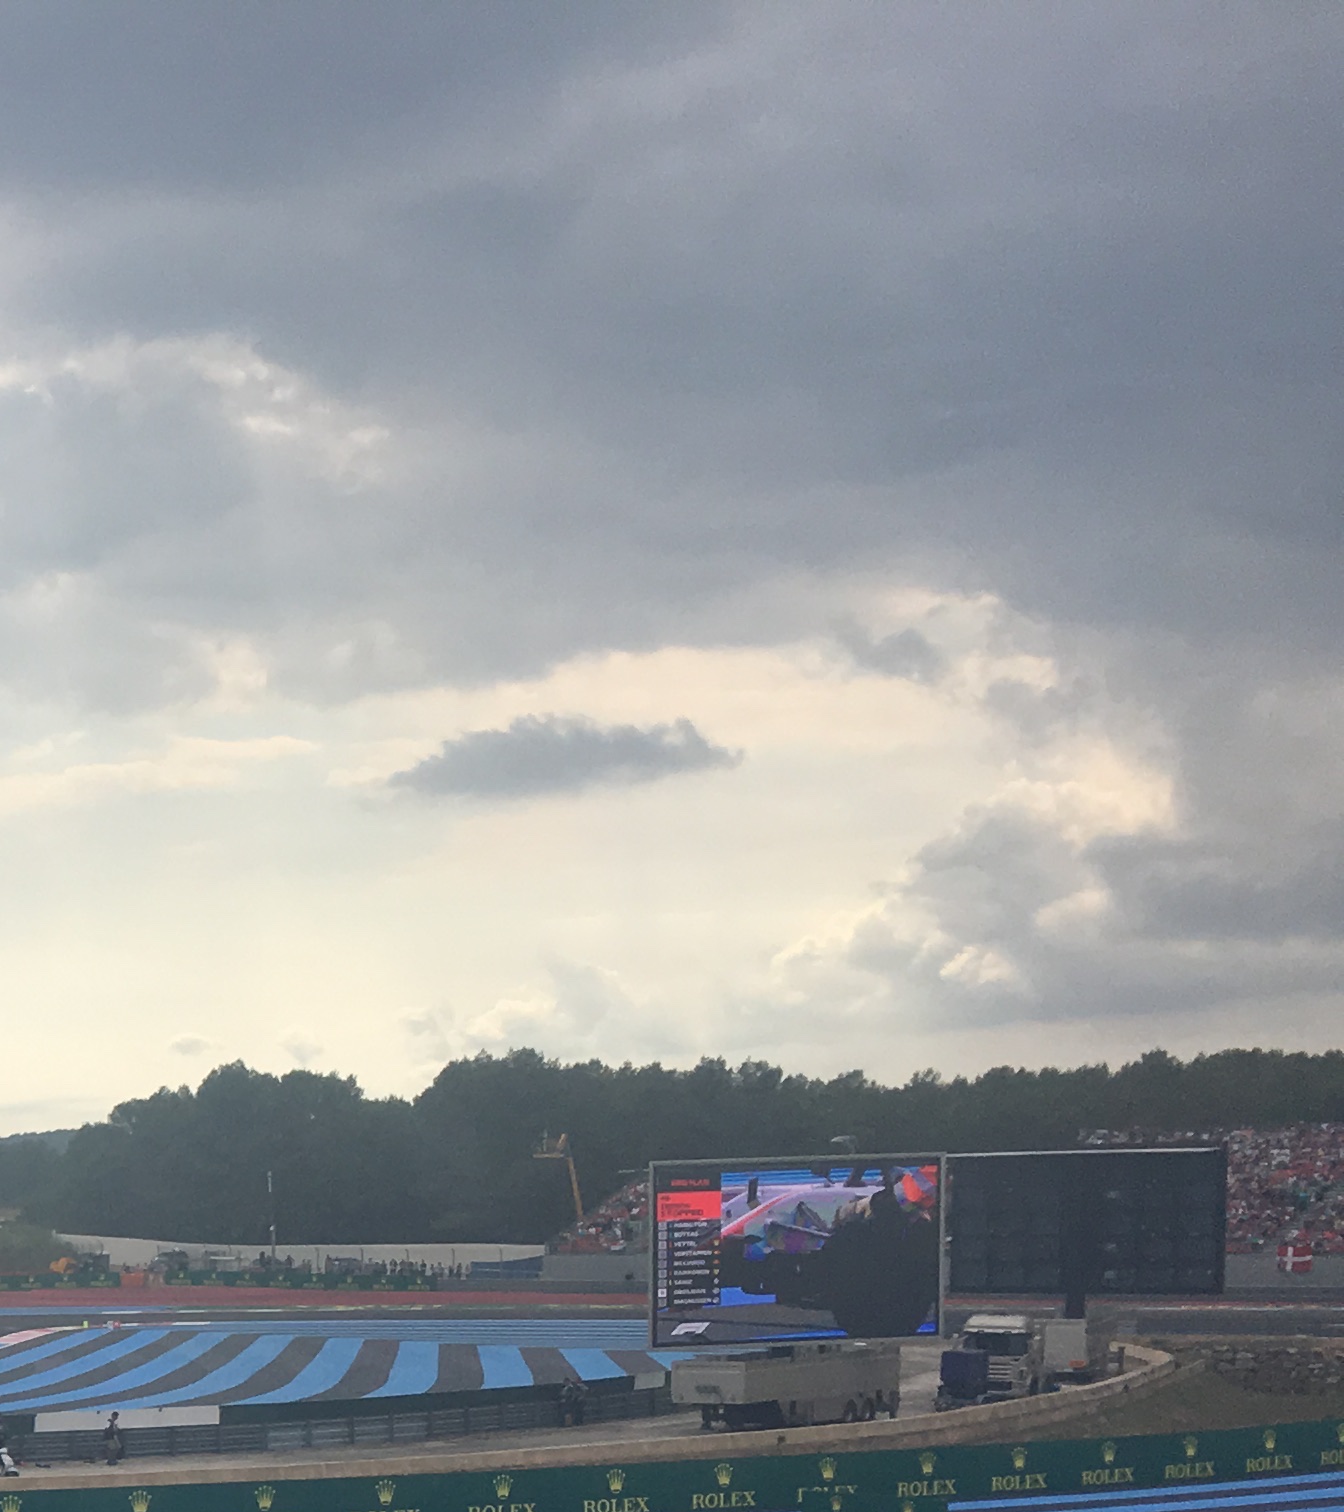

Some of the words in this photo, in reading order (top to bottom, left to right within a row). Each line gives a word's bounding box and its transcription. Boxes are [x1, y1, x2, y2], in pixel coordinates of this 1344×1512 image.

[1164, 1461, 1216, 1479] ROLEX
[1244, 1455, 1293, 1474] ROLEX
[990, 1473, 1047, 1491] ROLEX
[1080, 1467, 1133, 1485] ROLEX
[896, 1479, 957, 1497] ROLEX
[691, 1491, 756, 1510] ROLEX
